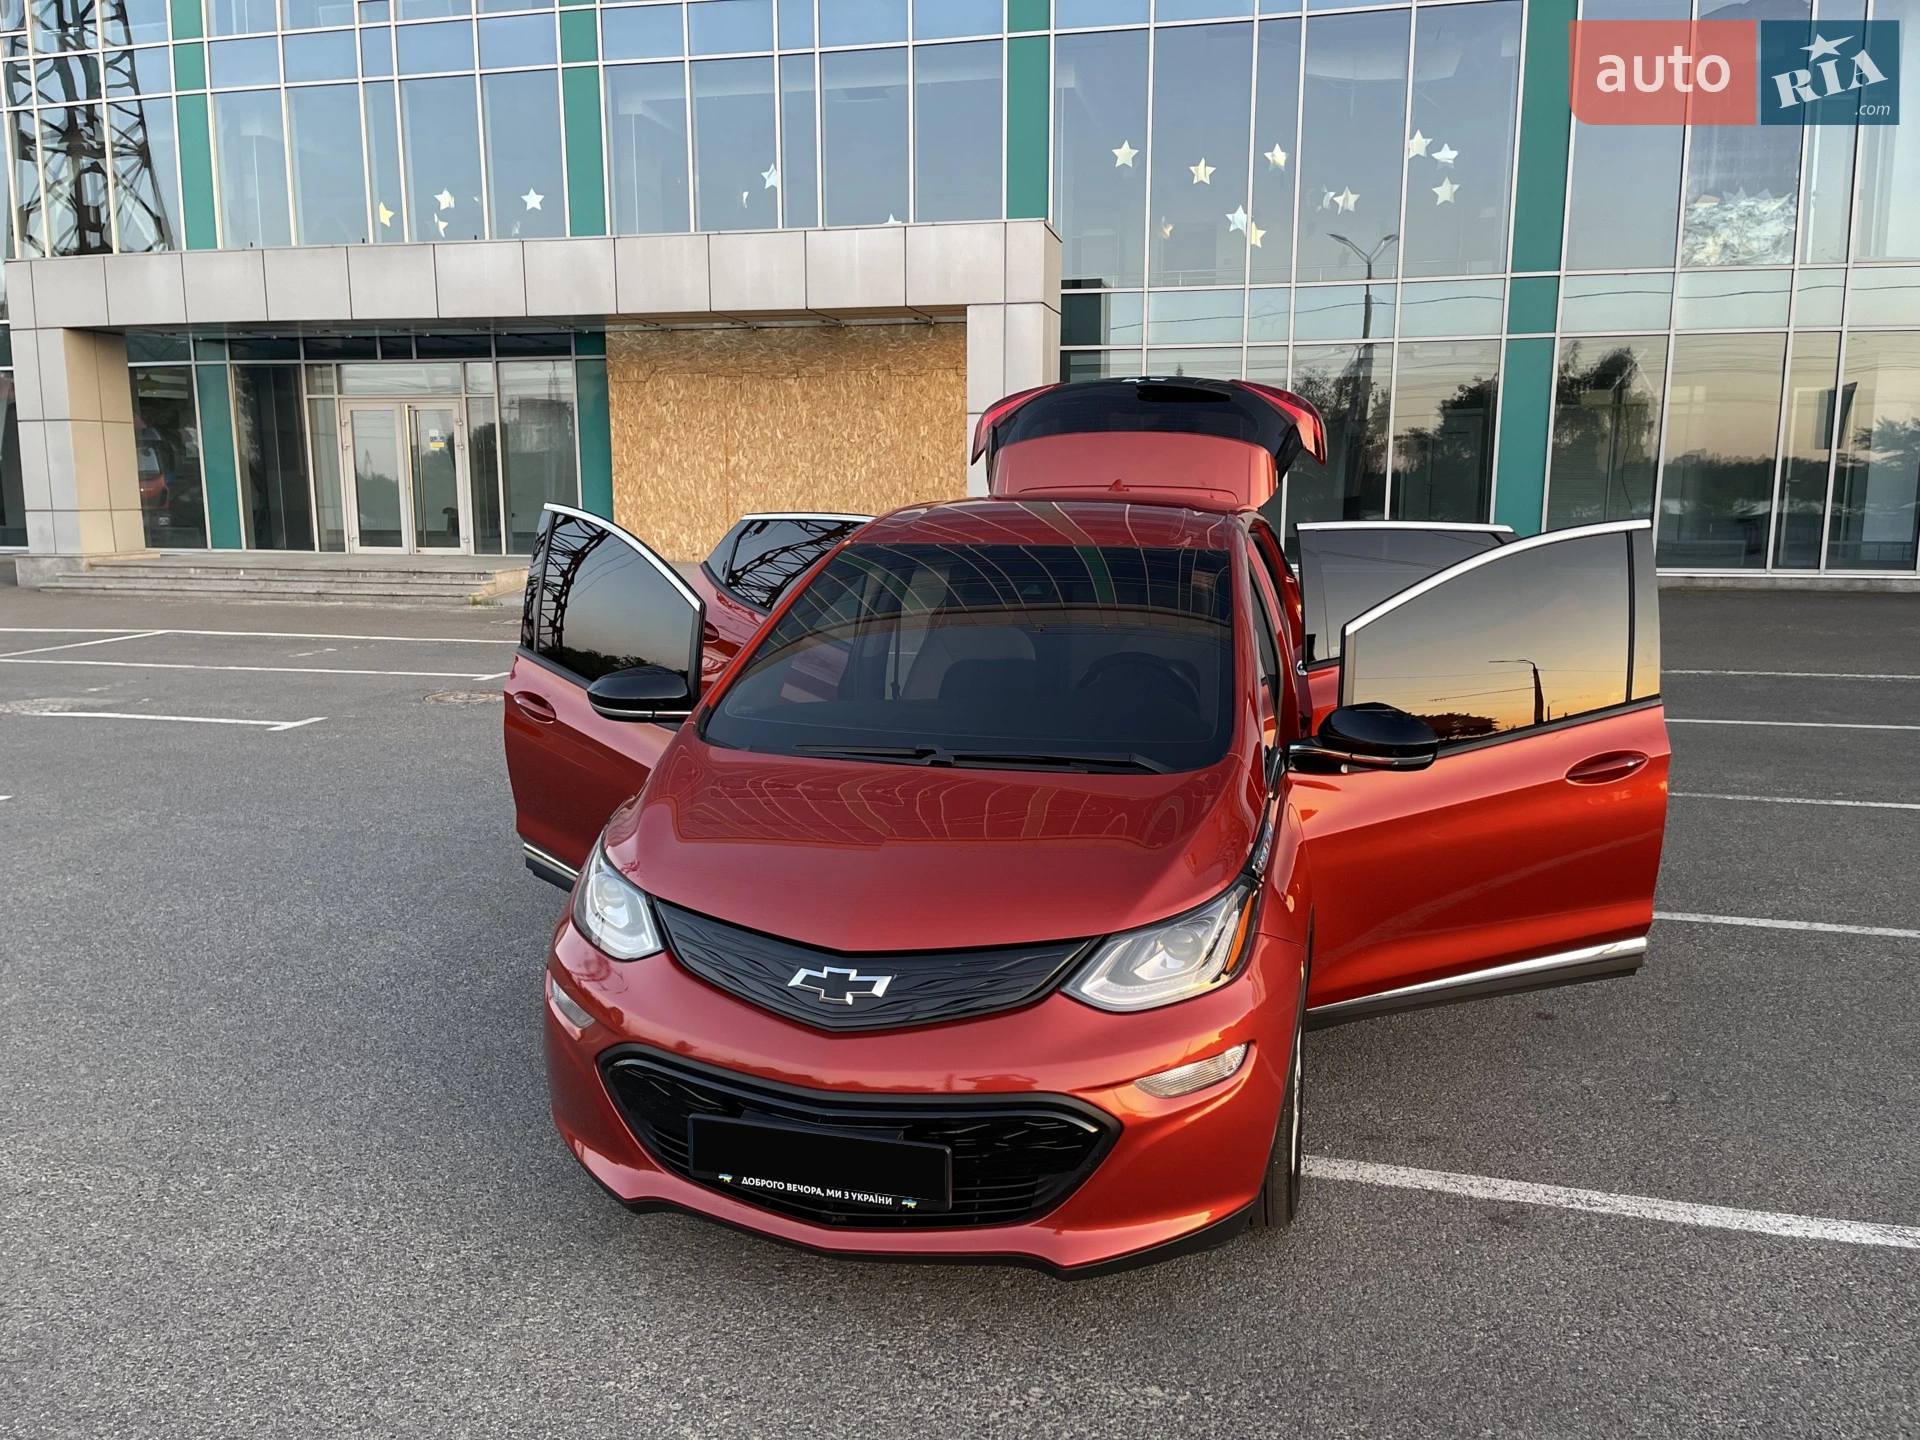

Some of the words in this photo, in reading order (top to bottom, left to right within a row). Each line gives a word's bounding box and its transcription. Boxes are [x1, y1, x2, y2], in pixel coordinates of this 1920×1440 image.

[741, 1176, 785, 1190] ДОБРОГО
[786, 1182, 825, 1197] ВЕЧОРА,
[826, 1188, 842, 1199] МИ
[843, 1190, 850, 1200] З
[850, 1192, 893, 1206] УКРАЇНИ
